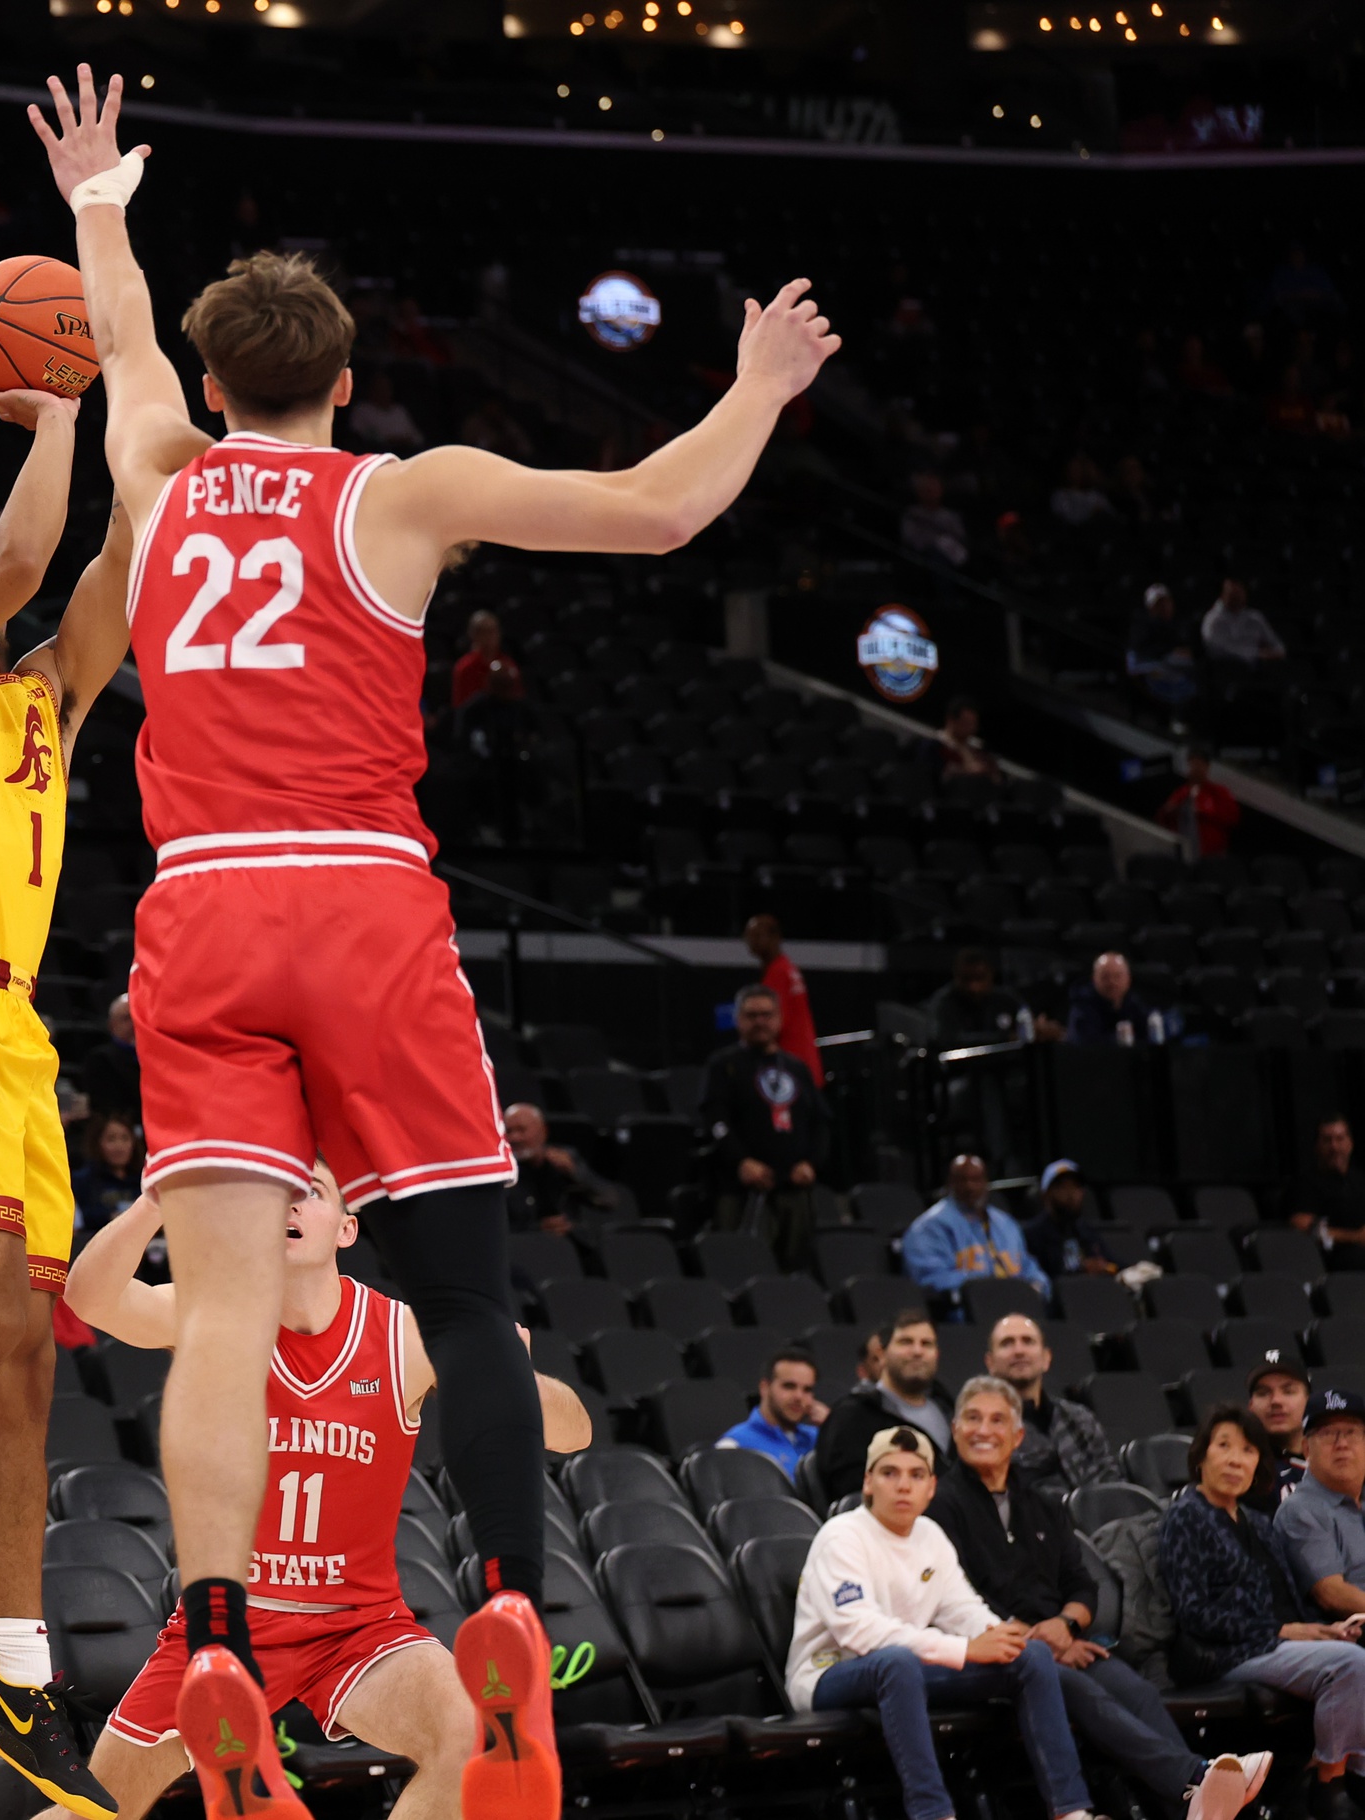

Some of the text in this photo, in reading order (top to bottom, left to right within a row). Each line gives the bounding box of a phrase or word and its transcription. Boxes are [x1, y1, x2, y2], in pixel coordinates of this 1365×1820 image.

[53, 310, 94, 341] SPA
[186, 463, 314, 519] PENCE
[164, 532, 305, 675] 22
[27, 810, 43, 888] 1
[349, 1377, 381, 1396] VALLEY
[268, 1416, 377, 1465] LINOIS
[278, 1470, 325, 1544] 11
[248, 1551, 347, 1587] STATE
